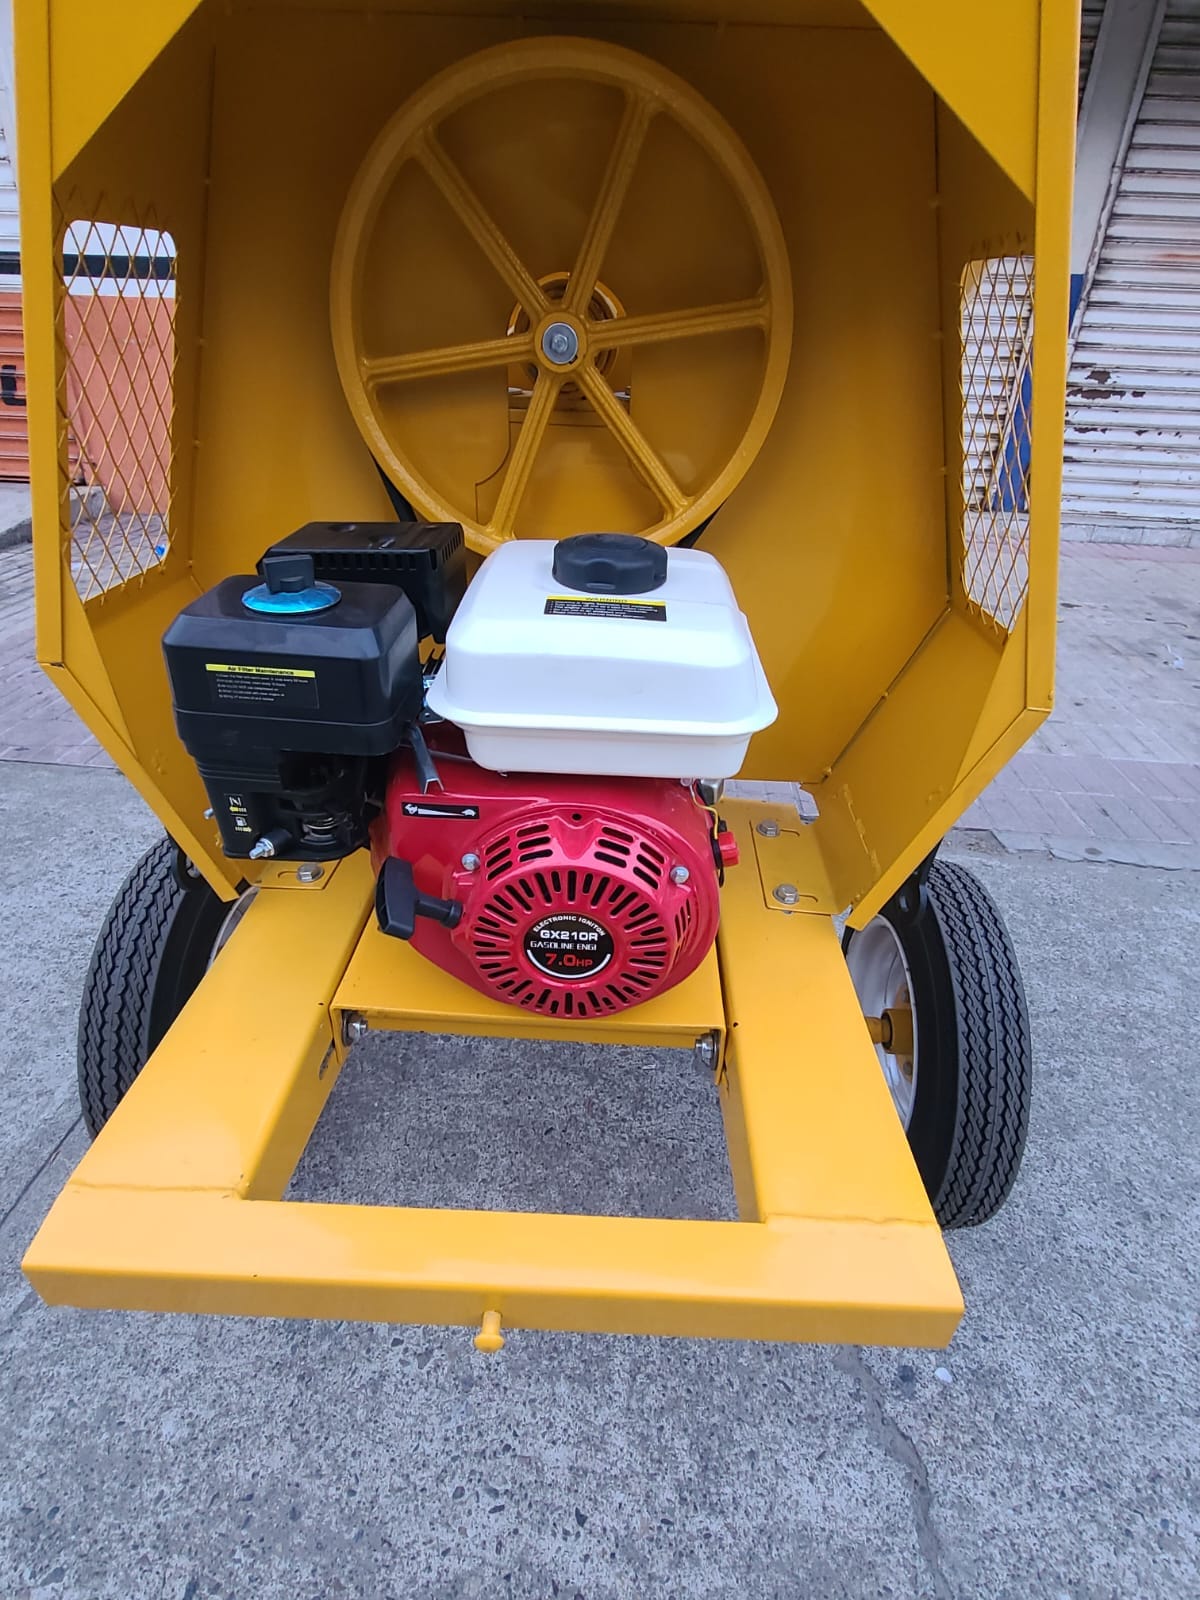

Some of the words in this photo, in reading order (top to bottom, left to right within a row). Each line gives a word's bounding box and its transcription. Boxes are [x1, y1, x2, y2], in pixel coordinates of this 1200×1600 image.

[532, 915, 577, 933] ELECTRONIC
[540, 929, 599, 942] GX210R
[530, 940, 575, 950] GASOLINE
[576, 943, 597, 951] ENGI
[545, 952, 593, 967] 7.0HP
